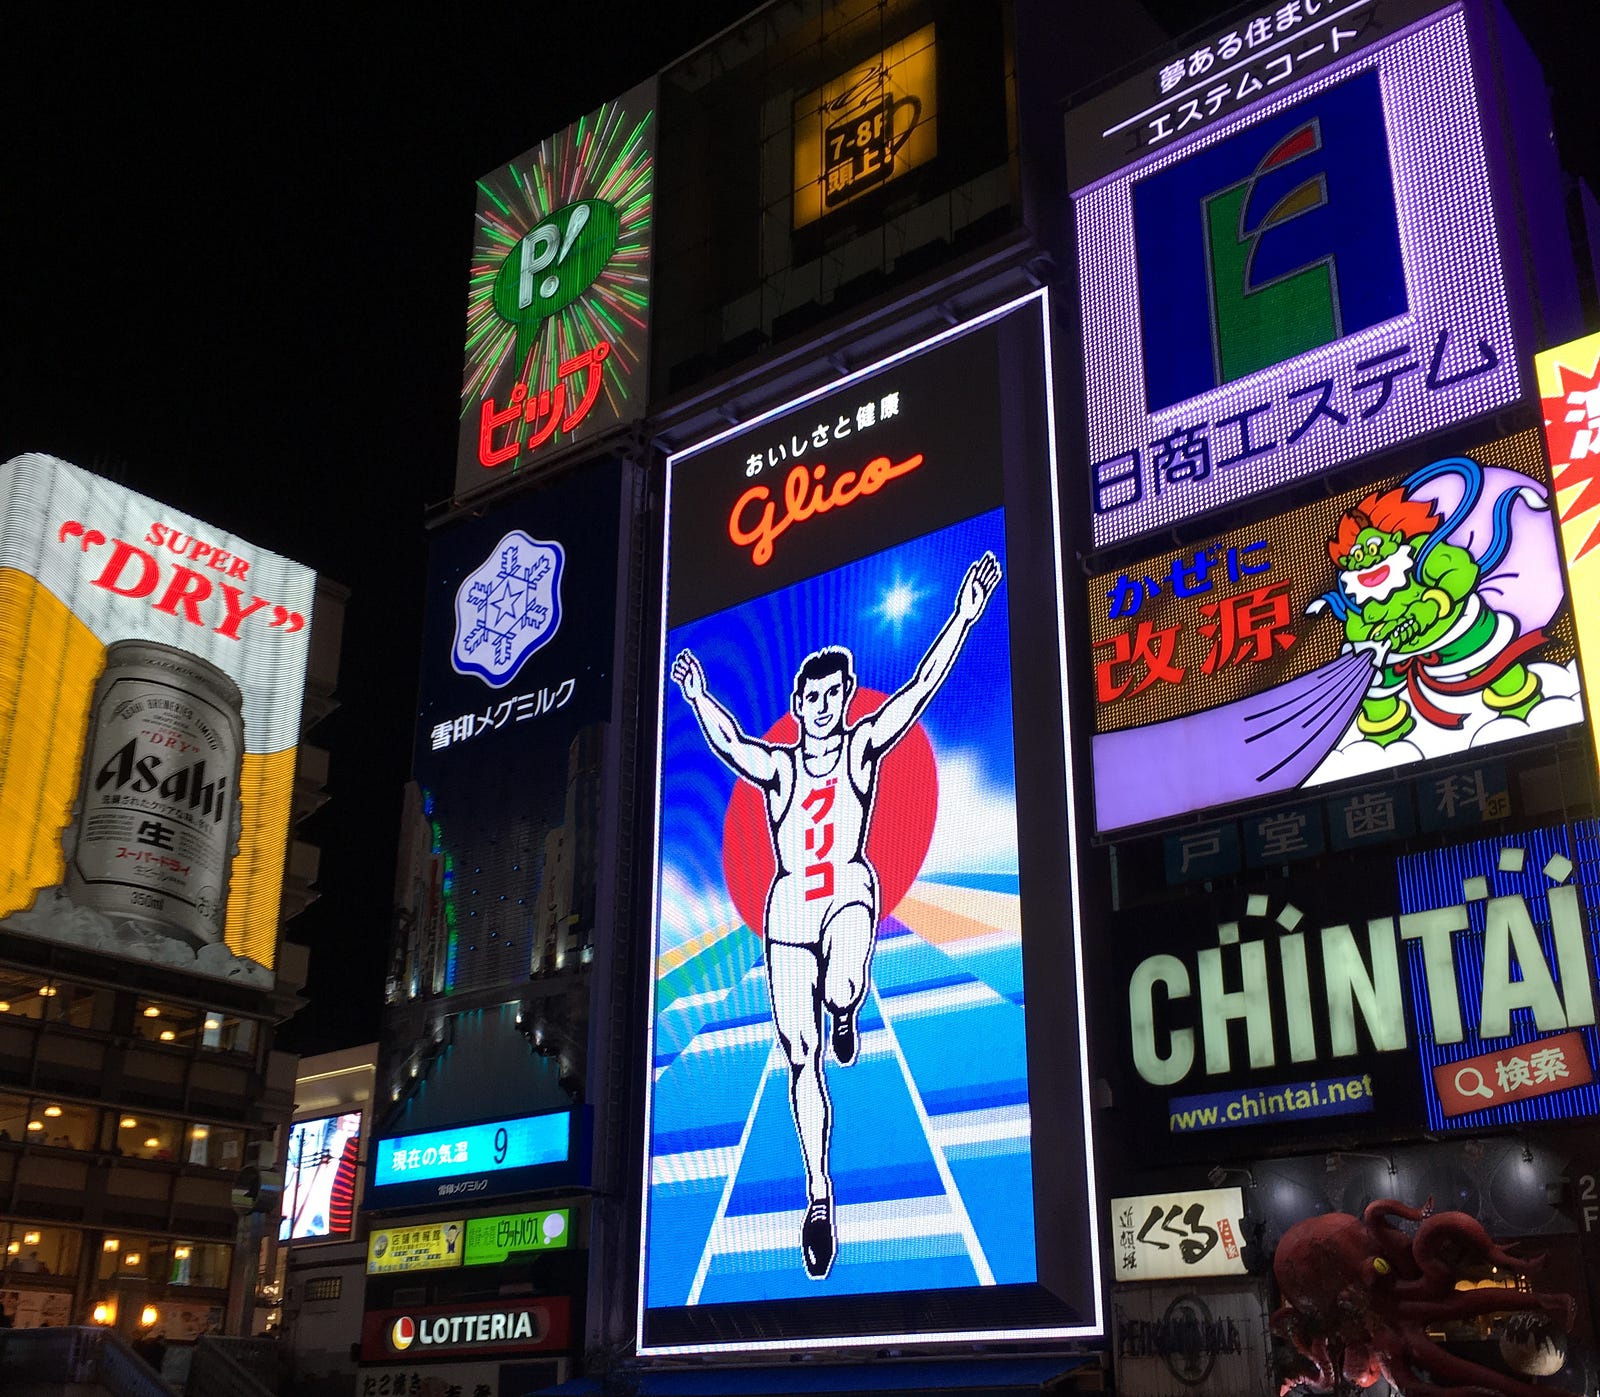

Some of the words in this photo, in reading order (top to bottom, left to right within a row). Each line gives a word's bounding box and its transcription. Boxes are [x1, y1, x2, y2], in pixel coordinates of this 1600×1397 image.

[1148, 26, 1357, 145] エステムコート
[829, 112, 891, 161] 7-8F
[519, 204, 590, 309] P!
[478, 341, 610, 467] ピップ
[745, 392, 900, 478] おいしさと健康
[1092, 329, 1500, 516] 日商エステム
[144, 521, 251, 583] SUPER
[728, 454, 924, 567] Glico
[1106, 540, 1271, 620] かぜに
[1092, 578, 1297, 704] 改源
[430, 678, 576, 751] 雪印メグミルク
[95, 736, 227, 826] Asahi
[1180, 769, 1489, 873] 戸堂歯科
[116, 847, 191, 876] スーパードライ
[136, 820, 175, 851] 生
[801, 777, 838, 902] グリコ
[1129, 847, 1597, 1086] CHINTAI
[1496, 1047, 1570, 1094] 検索
[391, 1140, 469, 1172] 現在の気温
[494, 1127, 509, 1165] 9
[1136, 1203, 1219, 1265] くくる
[419, 1311, 533, 1345] LOTTERIA
